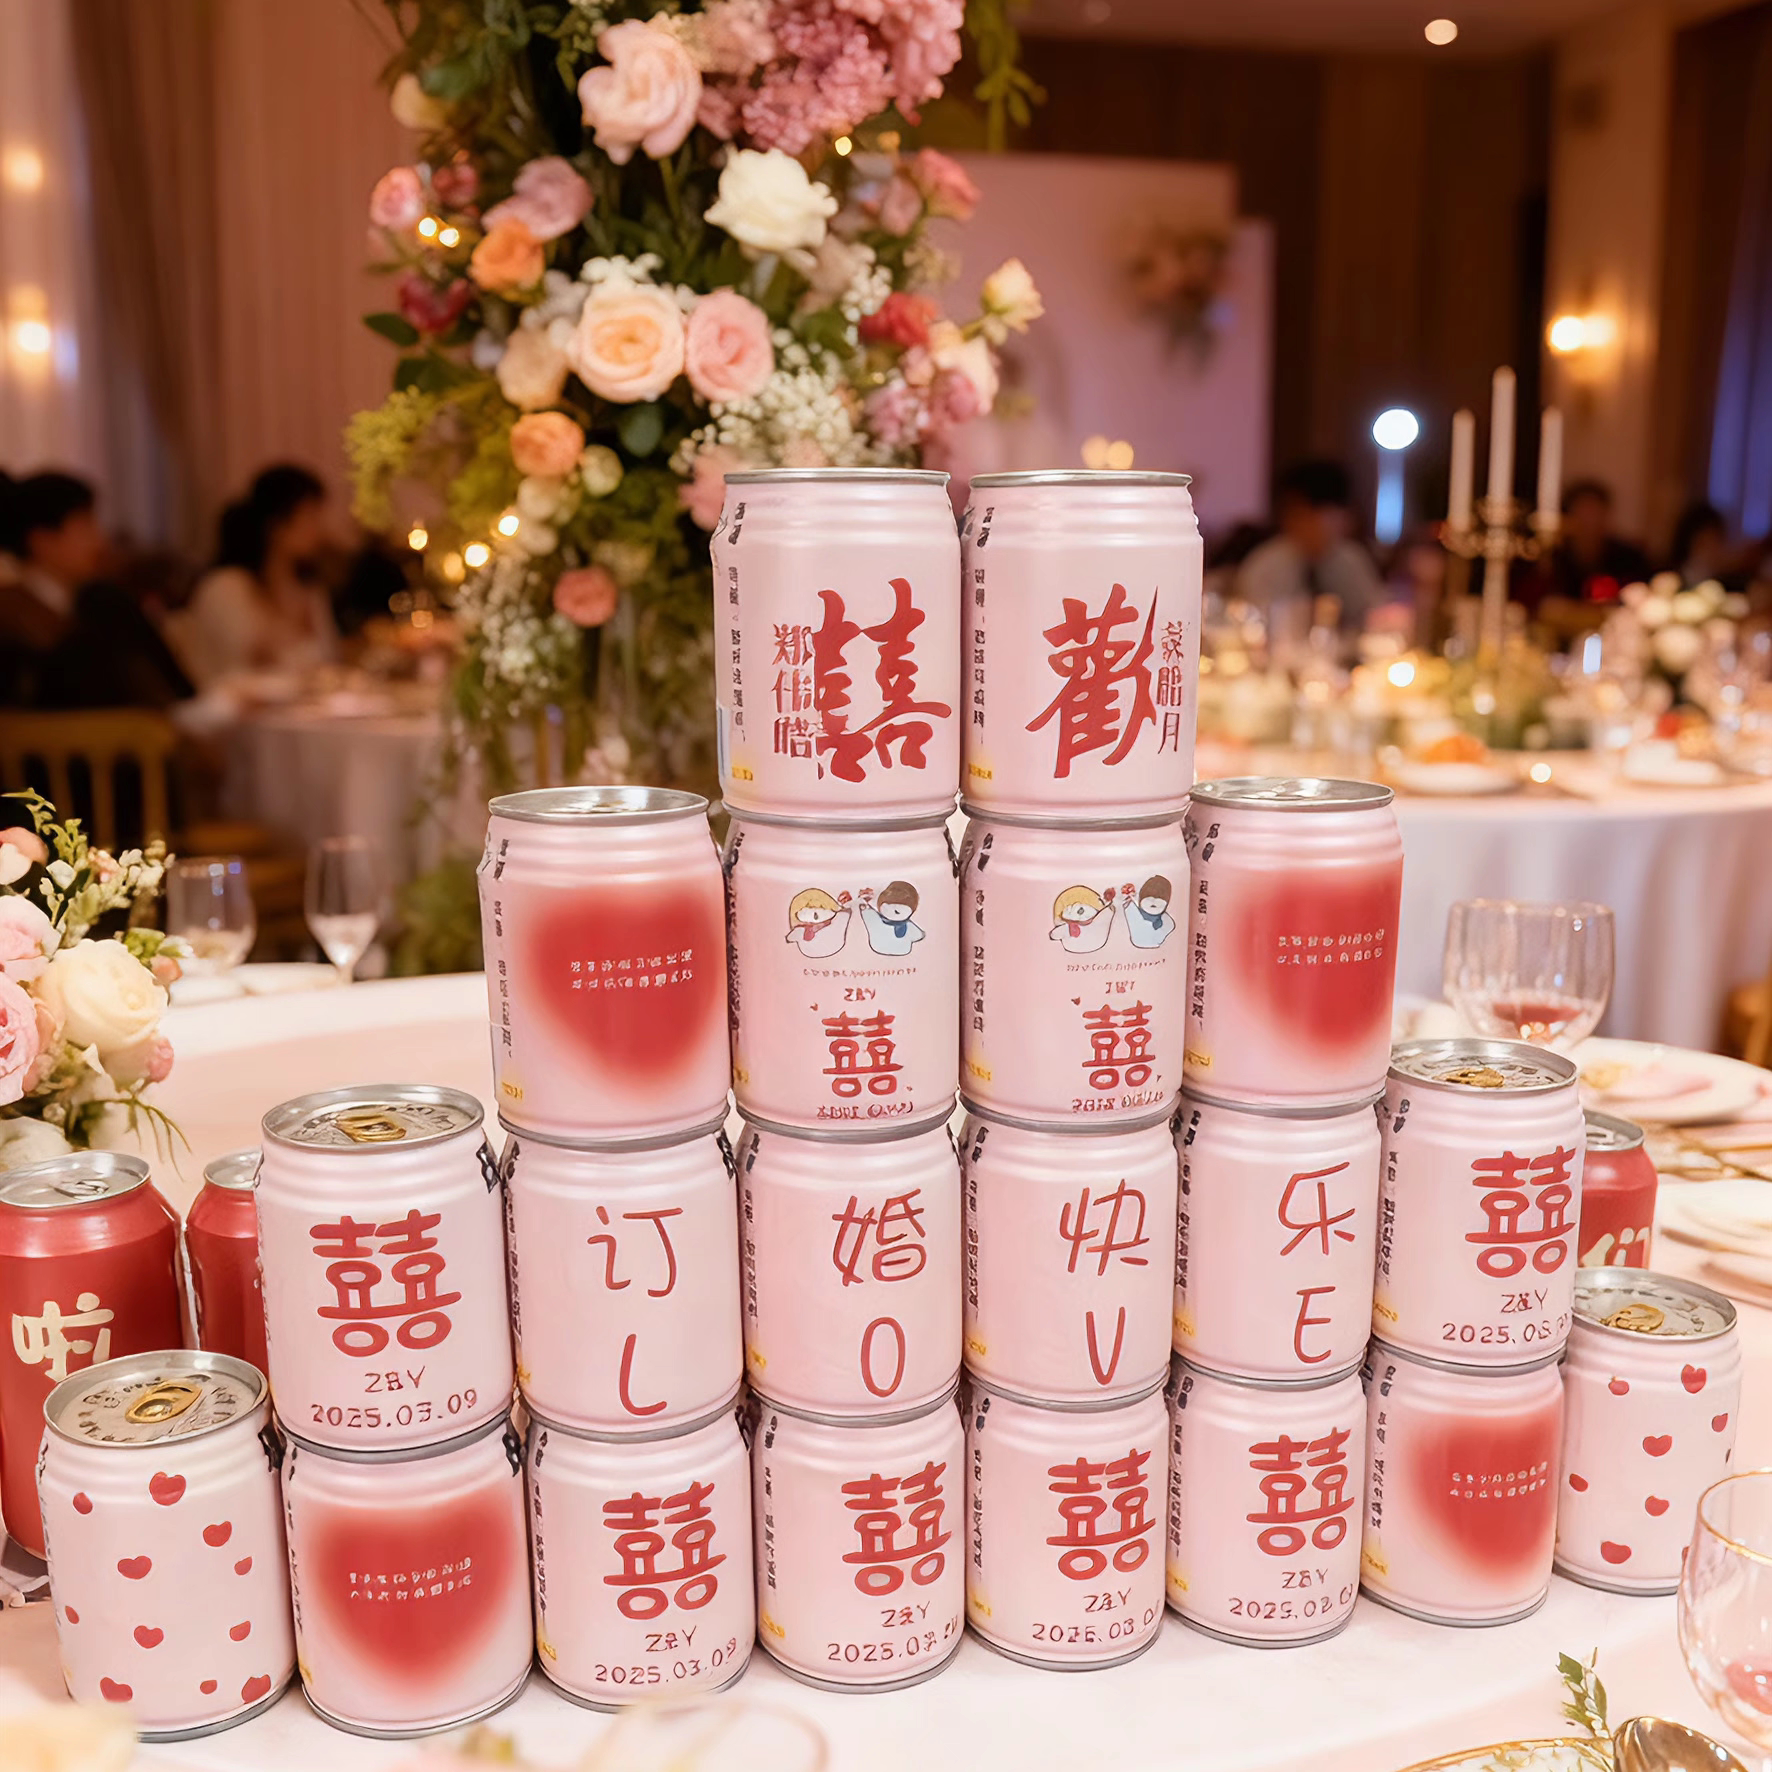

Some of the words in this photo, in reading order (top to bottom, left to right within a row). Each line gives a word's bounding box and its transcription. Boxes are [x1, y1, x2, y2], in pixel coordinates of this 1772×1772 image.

[587, 1205, 684, 1298] 订
[832, 1187, 927, 1288] 婚
[1059, 1178, 1150, 1276] 快
[1276, 1161, 1356, 1257] 乐
[311, 1388, 478, 1428] 2025.03.09
[618, 1333, 668, 1417] L
[1084, 1306, 1128, 1386] V
[1292, 1285, 1337, 1365] E
